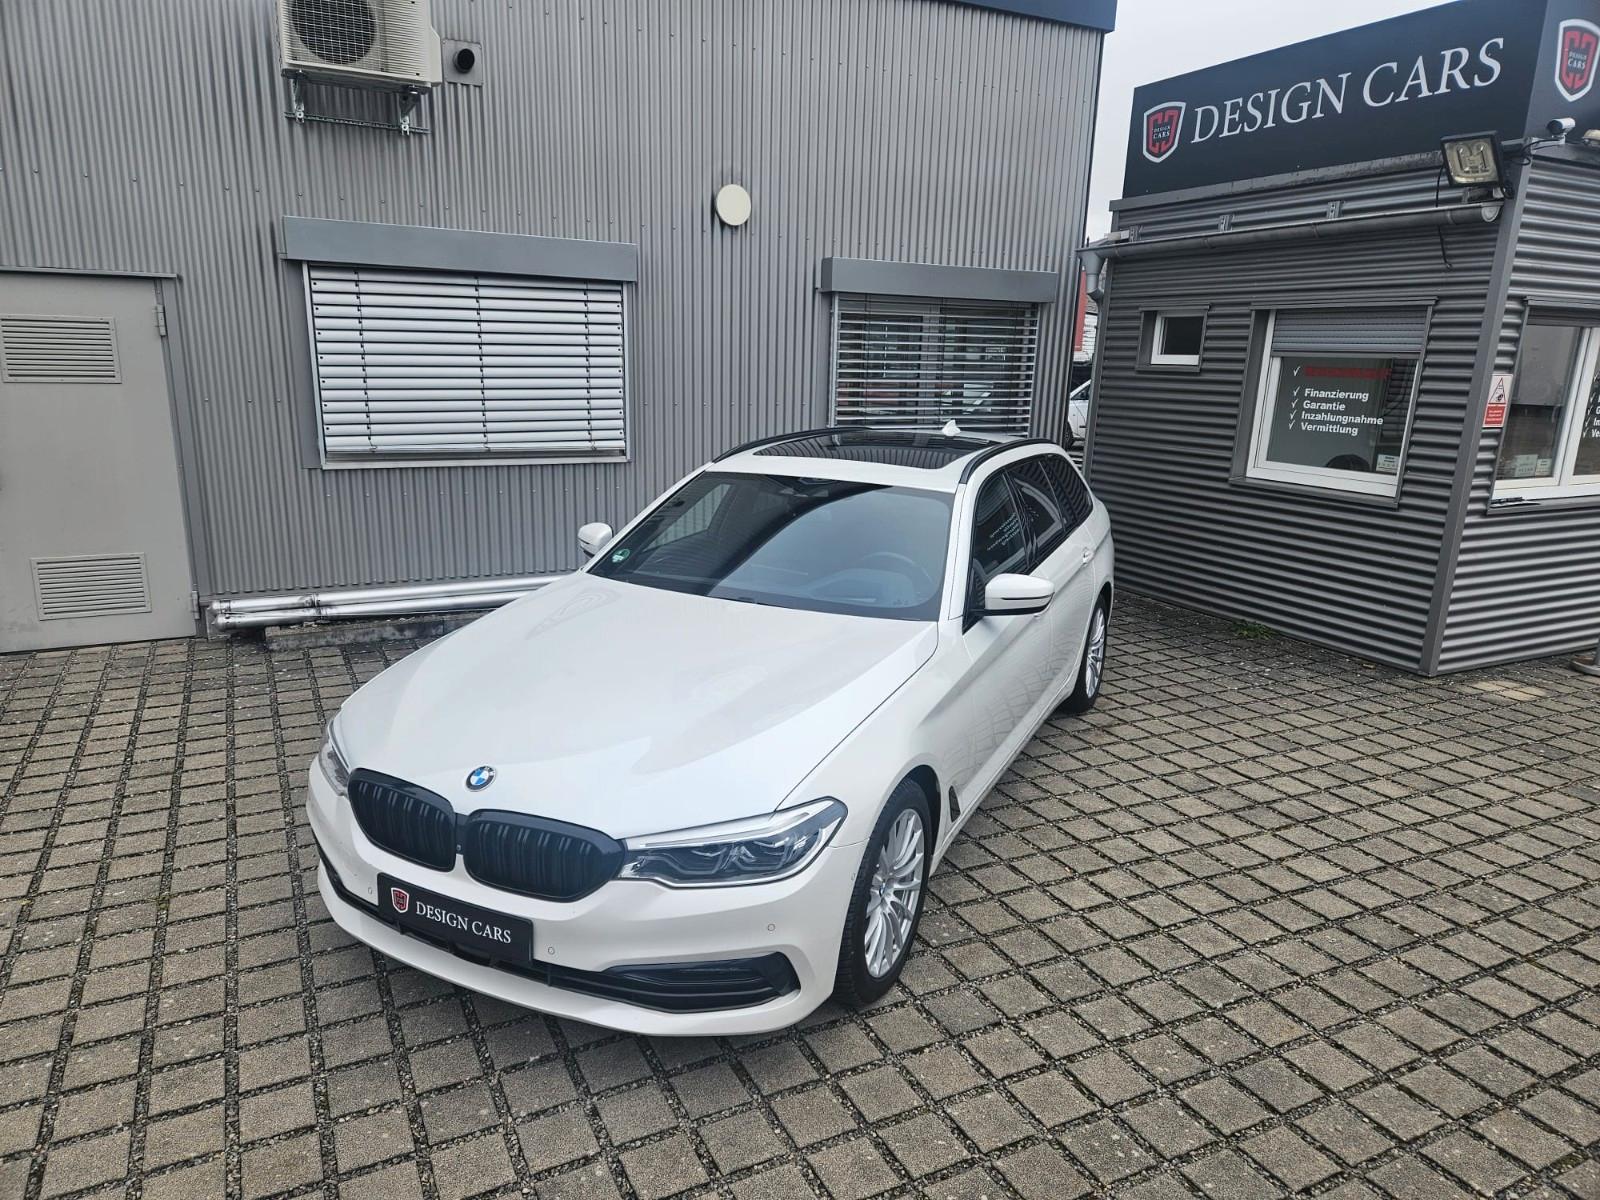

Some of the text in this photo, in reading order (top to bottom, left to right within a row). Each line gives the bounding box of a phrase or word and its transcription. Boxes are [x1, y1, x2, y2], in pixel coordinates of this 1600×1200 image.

[1567, 58, 1586, 70] CARS
[1191, 37, 1504, 144] DESIGN CARS
[1153, 131, 1170, 139] CARS
[1304, 388, 1369, 401] Finanzierung
[1303, 400, 1346, 411] Garantie
[1301, 411, 1384, 425] Inzahlungnahme
[1301, 422, 1358, 436] Vermittlung
[416, 901, 512, 944] DESIGN CARS
